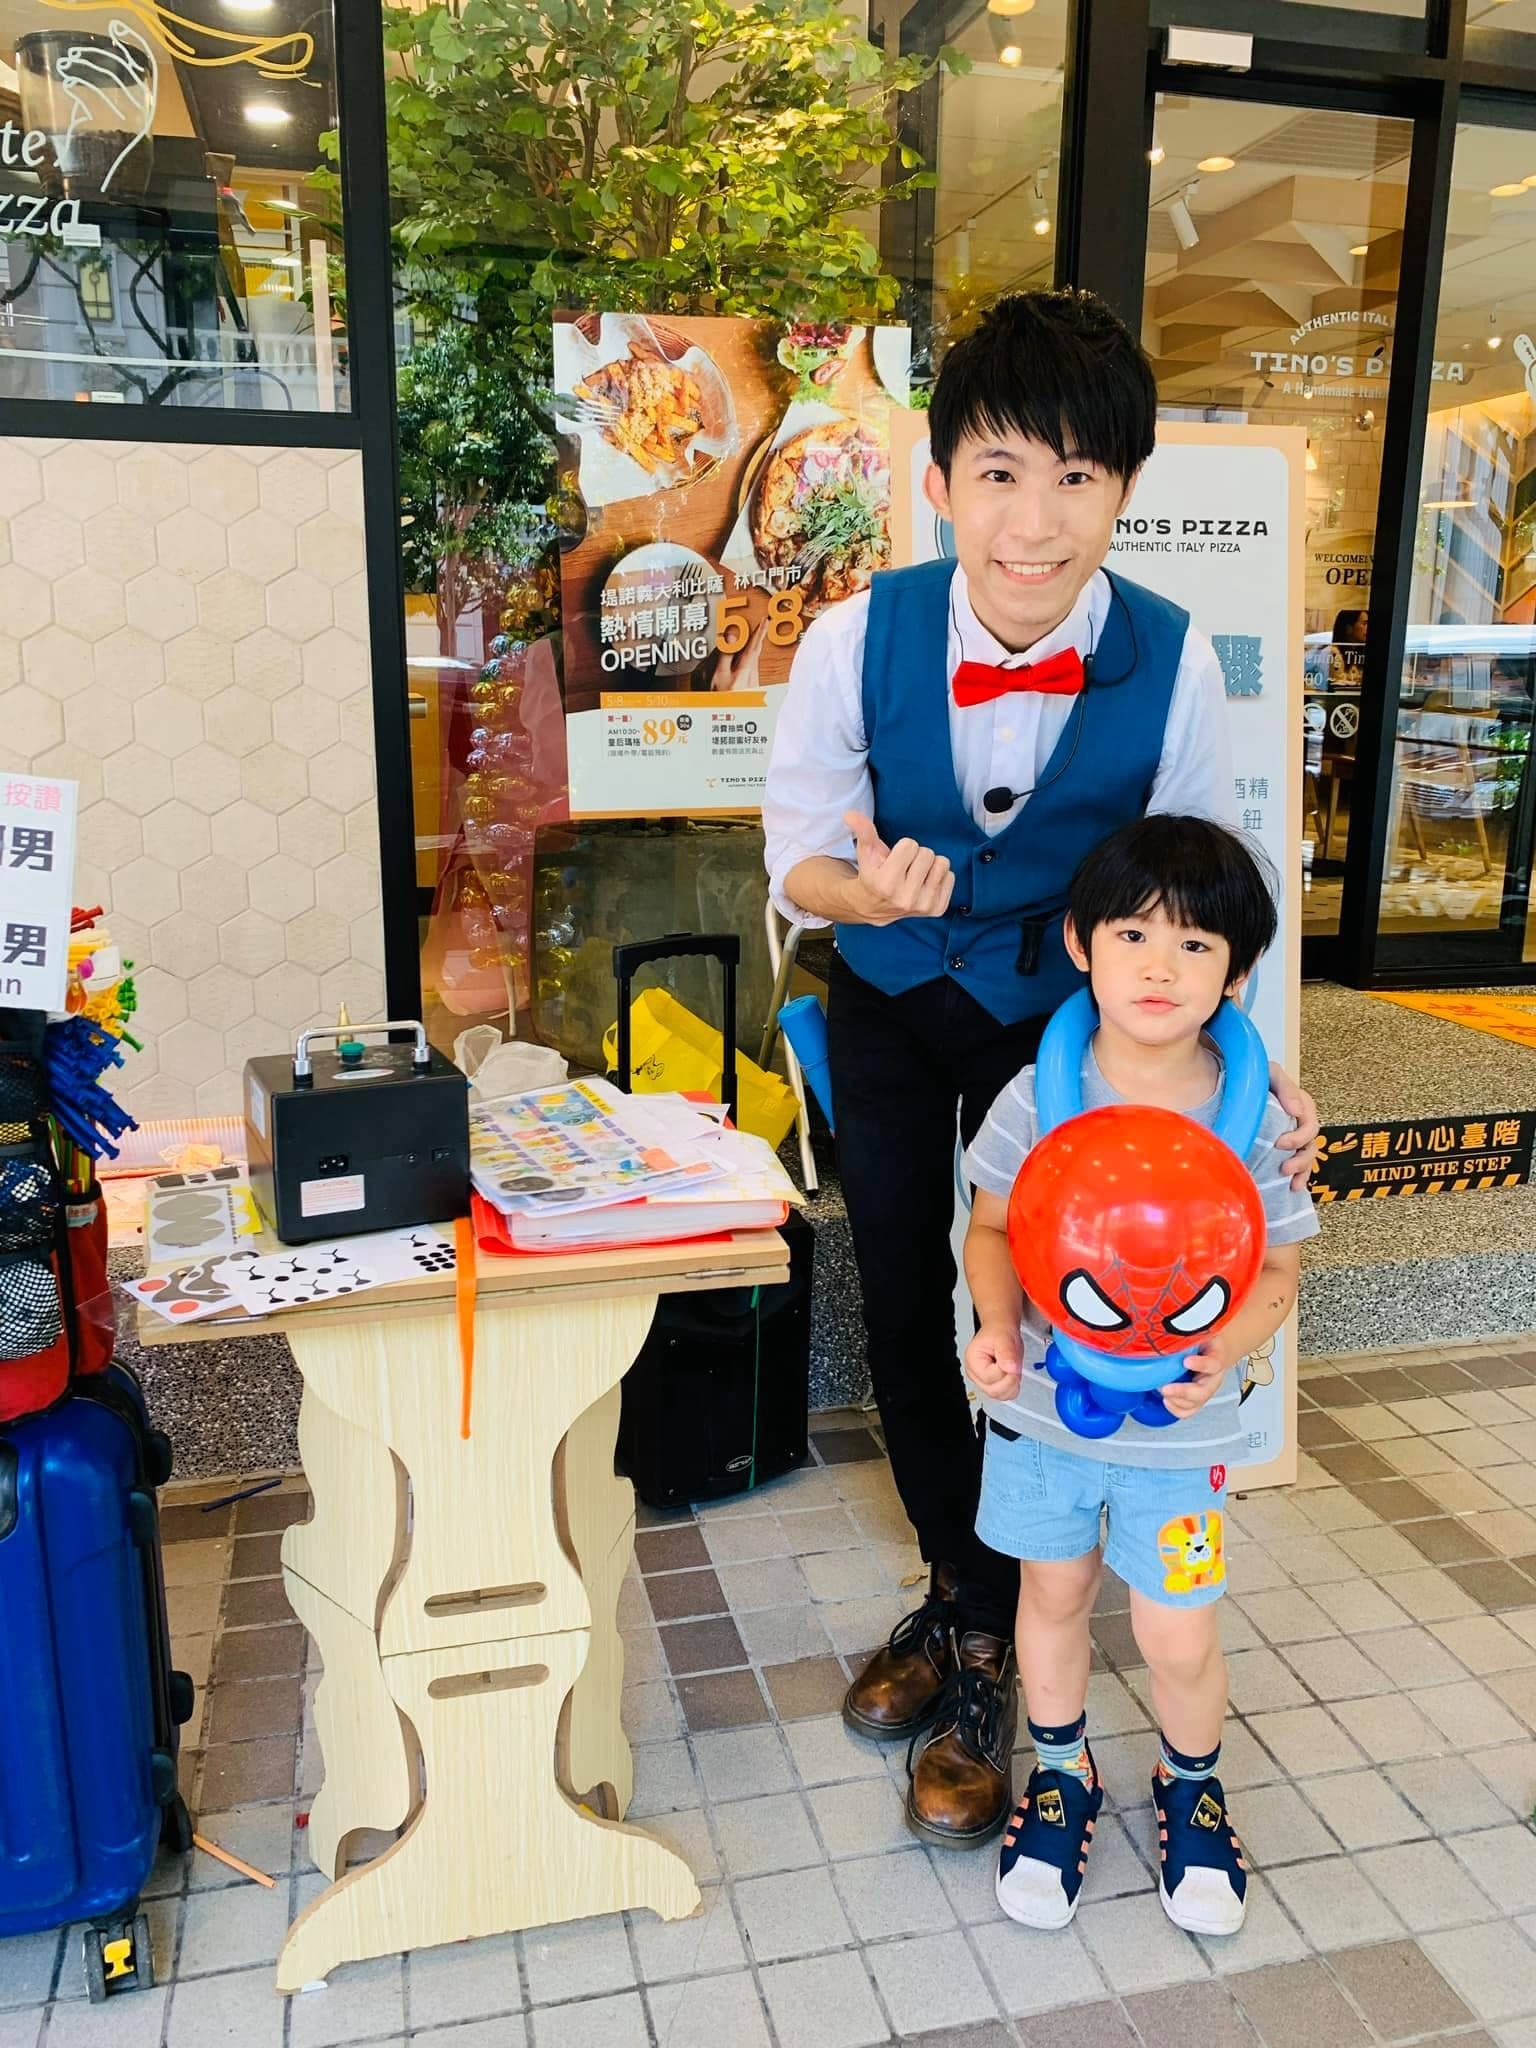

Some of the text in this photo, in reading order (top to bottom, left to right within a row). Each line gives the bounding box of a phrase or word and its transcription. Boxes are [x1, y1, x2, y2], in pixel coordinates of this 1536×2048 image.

[1289, 311, 1359, 346] AUTHENTIC
[1250, 352, 1353, 376] TINO'S
[1182, 520, 1268, 536] PIZZA
[1108, 541, 1241, 553] AUTHENTIC ITALY PIZZA
[734, 565, 802, 590] 林口門市
[600, 602, 709, 644] 熱情開幕
[600, 636, 708, 672] OPENING
[642, 718, 676, 745] 89
[6, 783, 62, 813] 按讚
[1360, 1119, 1521, 1159] 請小心臺階
[1362, 1156, 1512, 1183] MIND THE STEP
